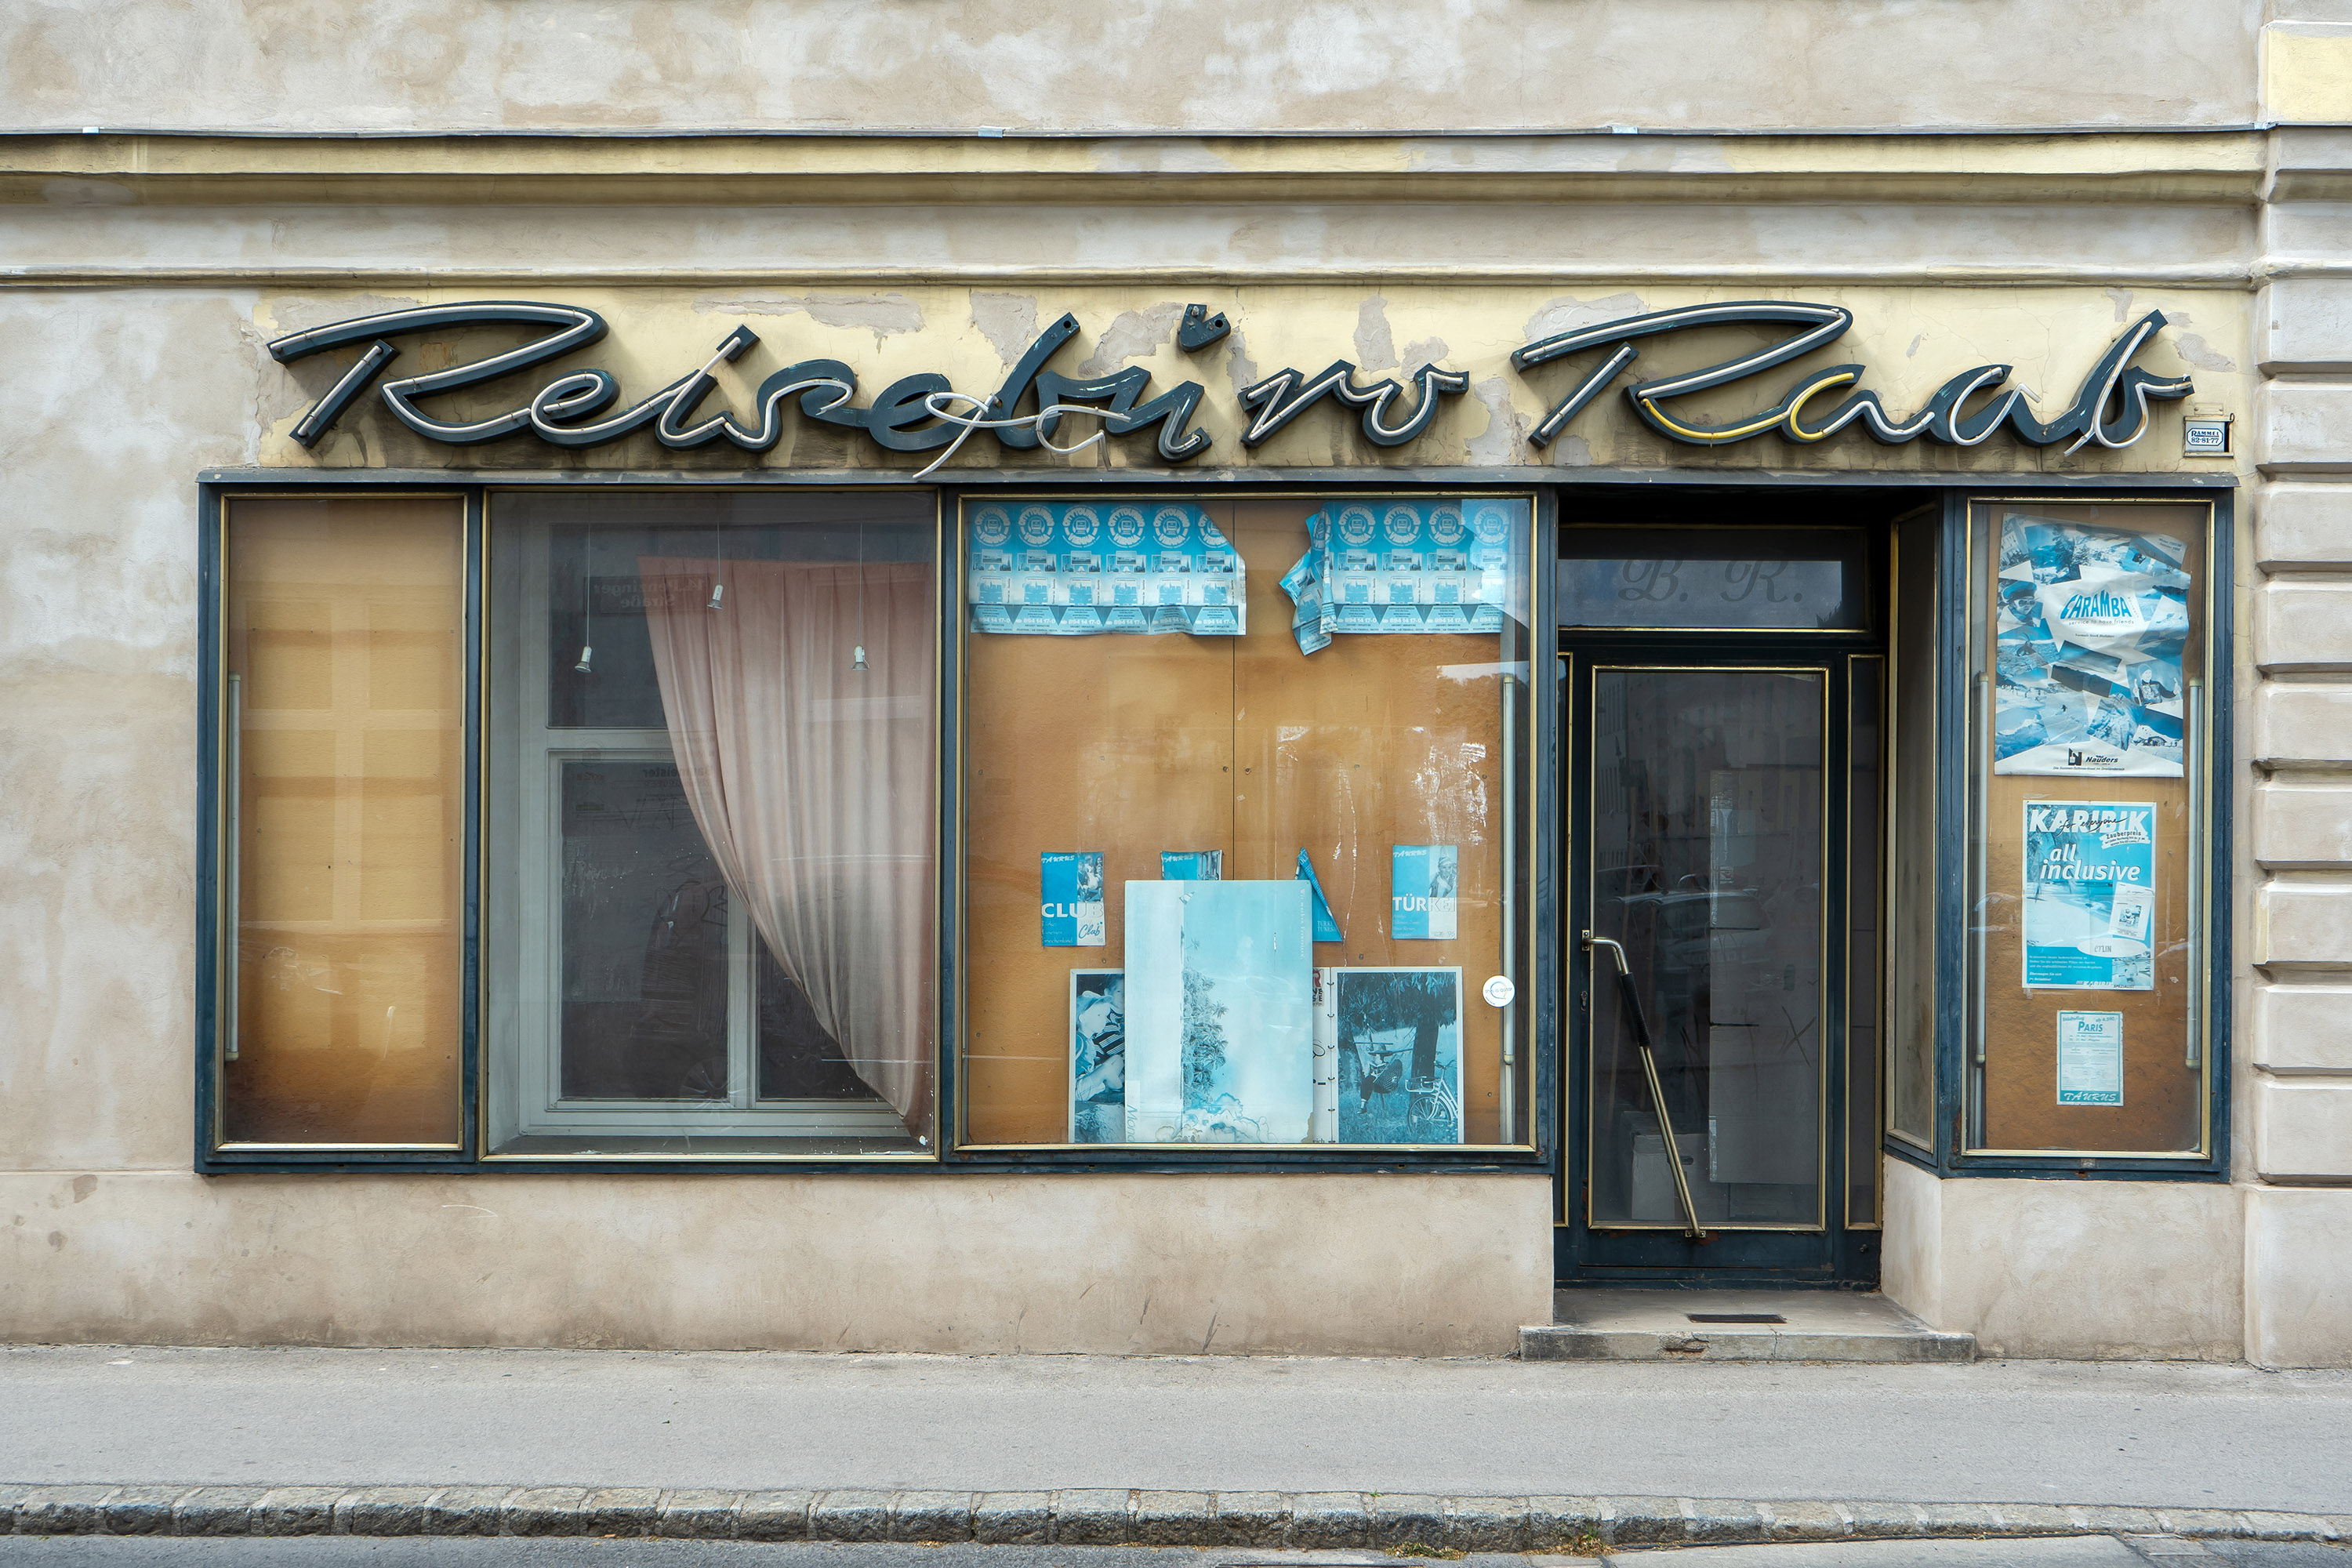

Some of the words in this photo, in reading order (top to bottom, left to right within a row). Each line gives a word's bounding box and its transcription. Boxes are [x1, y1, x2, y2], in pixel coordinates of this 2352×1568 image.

[1511, 300, 2195, 456] Raab
[2060, 590, 2132, 619] CARAMBA
[2029, 809, 2149, 833] KARIBIK
[2056, 822, 2076, 837] for
[2080, 817, 2129, 833] everyone
[2106, 830, 2142, 840] Zauberpreis
[2049, 844, 2077, 862] all
[2040, 858, 2142, 881] inclusive
[1042, 903, 1104, 918] CLUB
[1392, 893, 1456, 913] TÜRKEI
[1079, 924, 1101, 939] Club
[2078, 1021, 2103, 1033] PARIS
[2063, 1091, 2117, 1102] TAURUS
